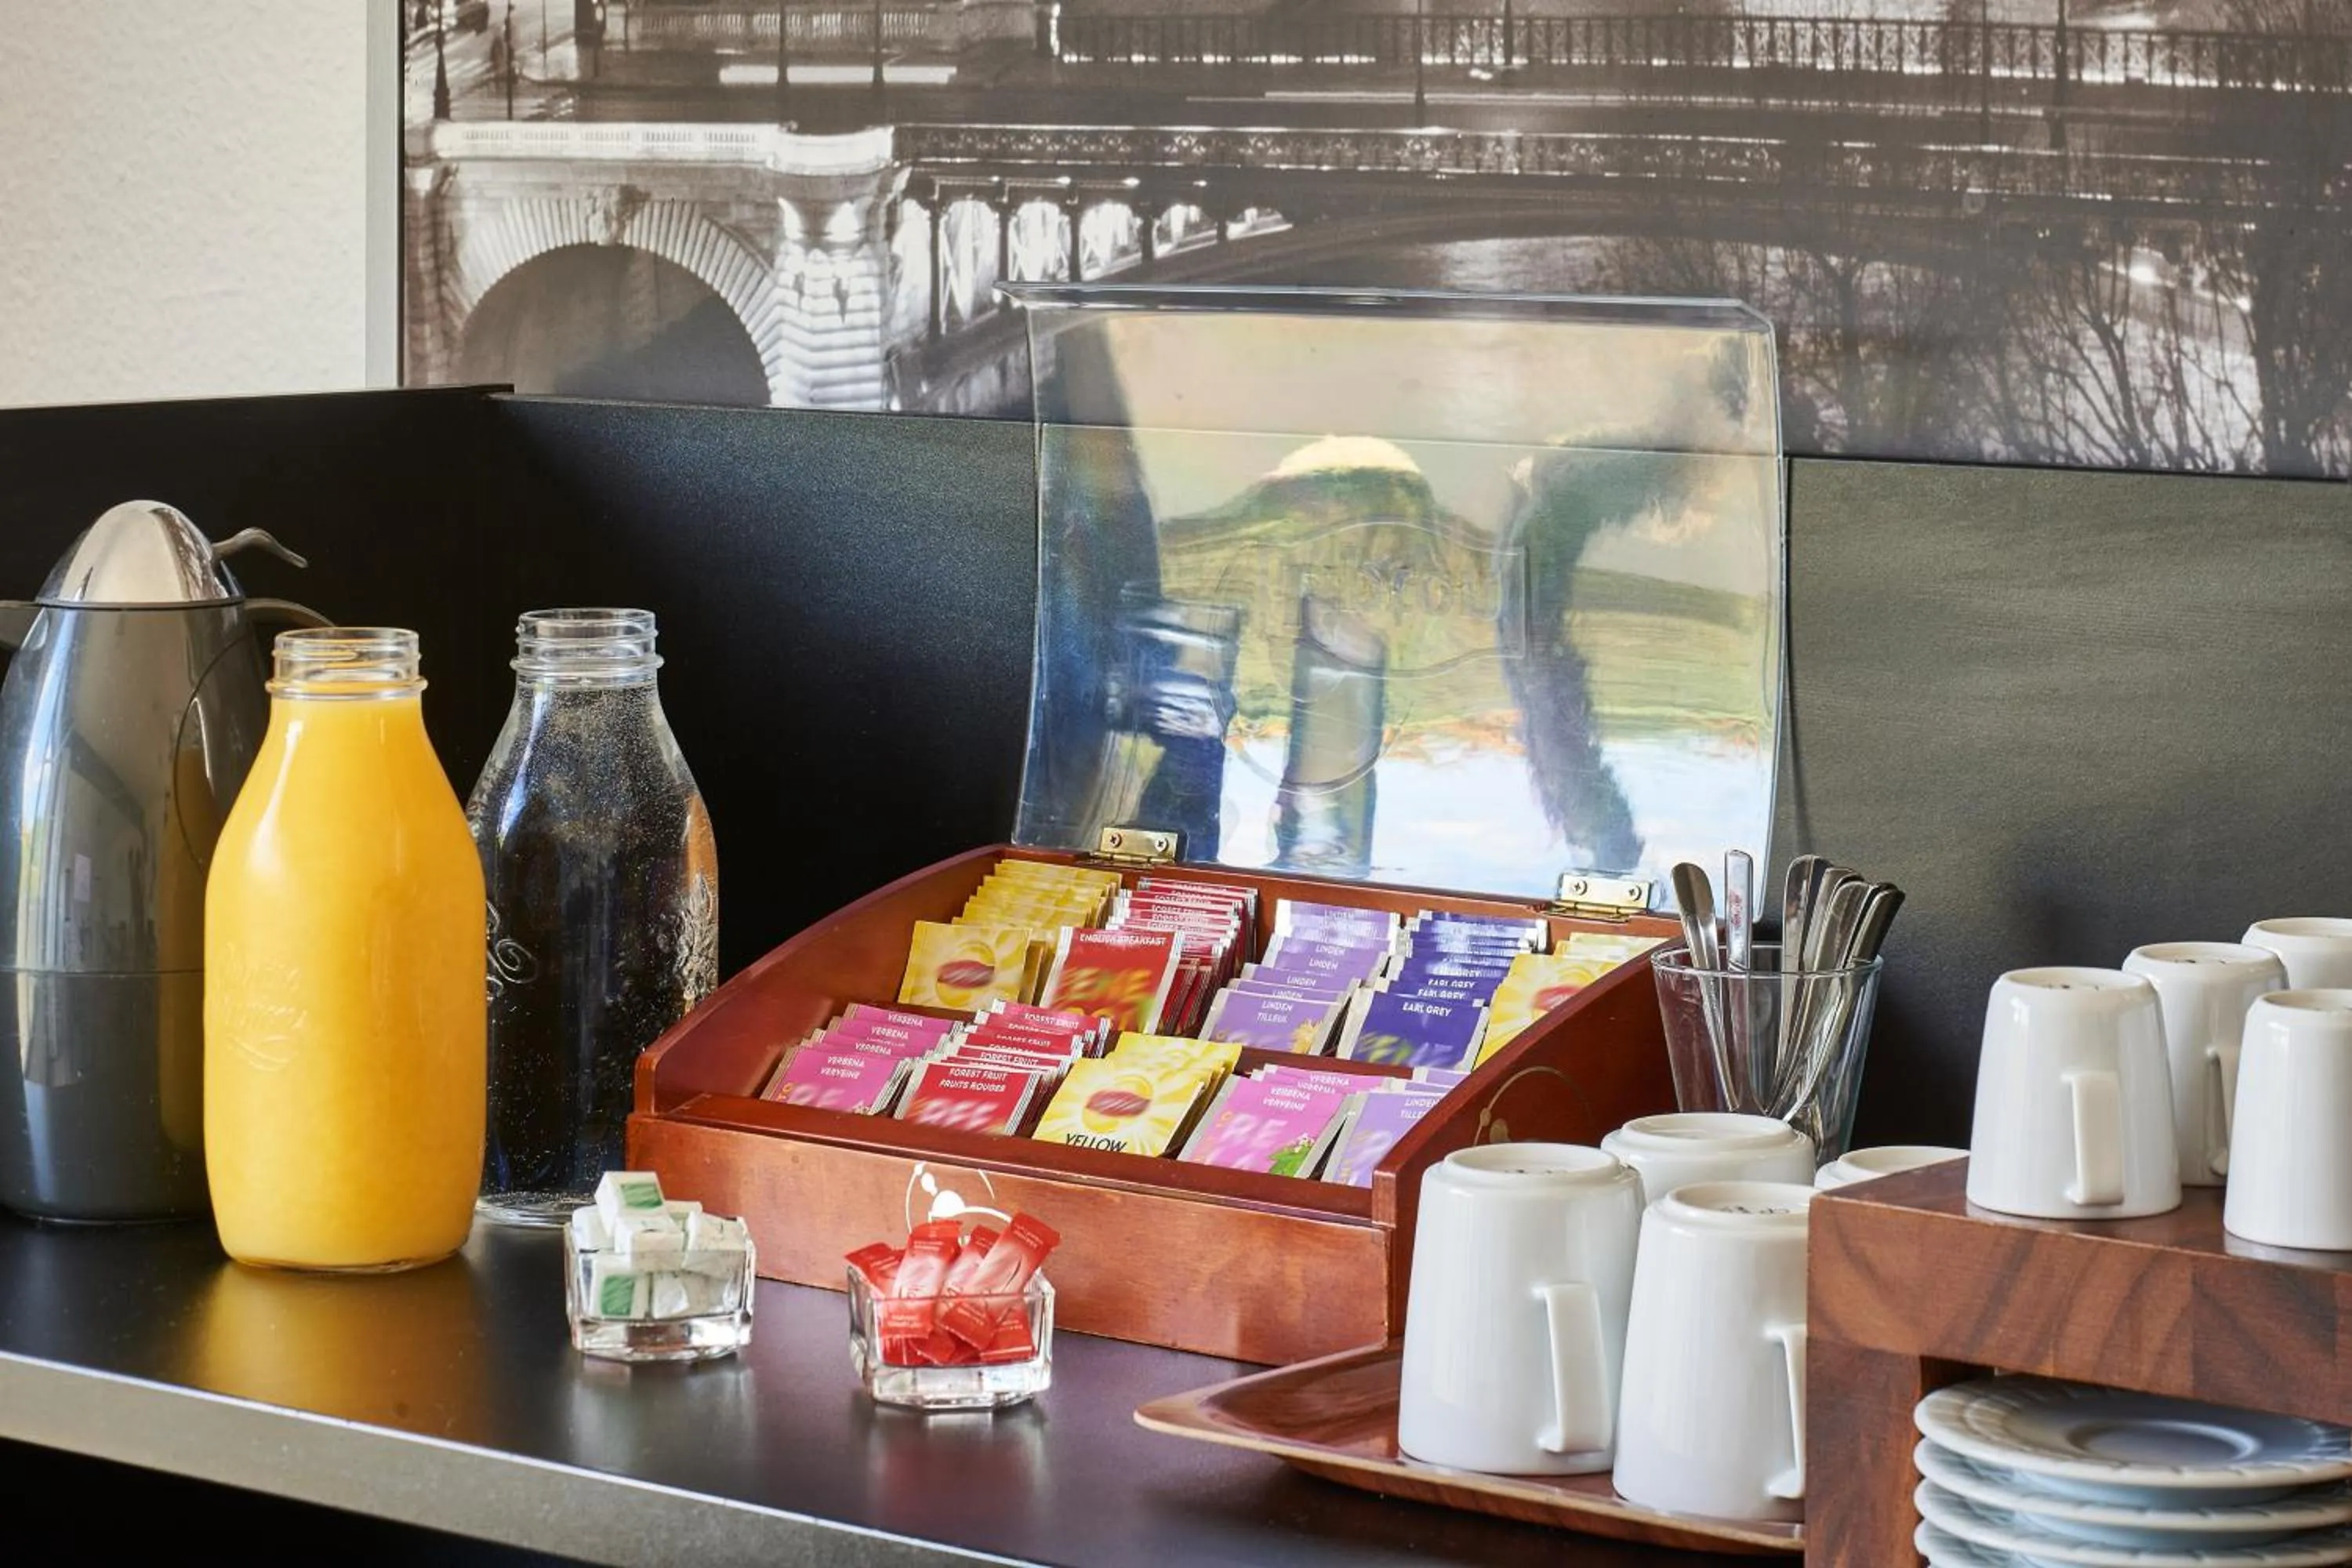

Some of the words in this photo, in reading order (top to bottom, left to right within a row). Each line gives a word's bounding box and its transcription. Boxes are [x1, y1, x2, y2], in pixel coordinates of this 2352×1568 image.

[1113, 935, 1167, 947] BREAKFAST
[1316, 943, 1346, 956] LINDEN
[1308, 958, 1339, 970] LINDEN
[1287, 975, 1317, 986] LINDEN
[1261, 1000, 1294, 1011] LINDEN
[1402, 1001, 1425, 1013] EARL
[1425, 1004, 1453, 1017] GREY
[871, 1025, 909, 1040] VERBENA
[855, 1042, 892, 1056] VERBENA
[827, 1055, 865, 1068] VERBENA
[980, 1051, 1013, 1063] FOREST
[1013, 1055, 1039, 1066] FRUIT
[949, 1067, 982, 1079] FOREST
[982, 1069, 1008, 1080] FRUIT
[1310, 1073, 1350, 1086] VERBENA
[938, 1079, 970, 1091] FRUITS
[970, 1080, 1007, 1093] ROUGES
[1270, 1087, 1311, 1101] VERBENA
[1262, 1097, 1305, 1112] VERVEINE
[1065, 1133, 1128, 1152] YELLOW
